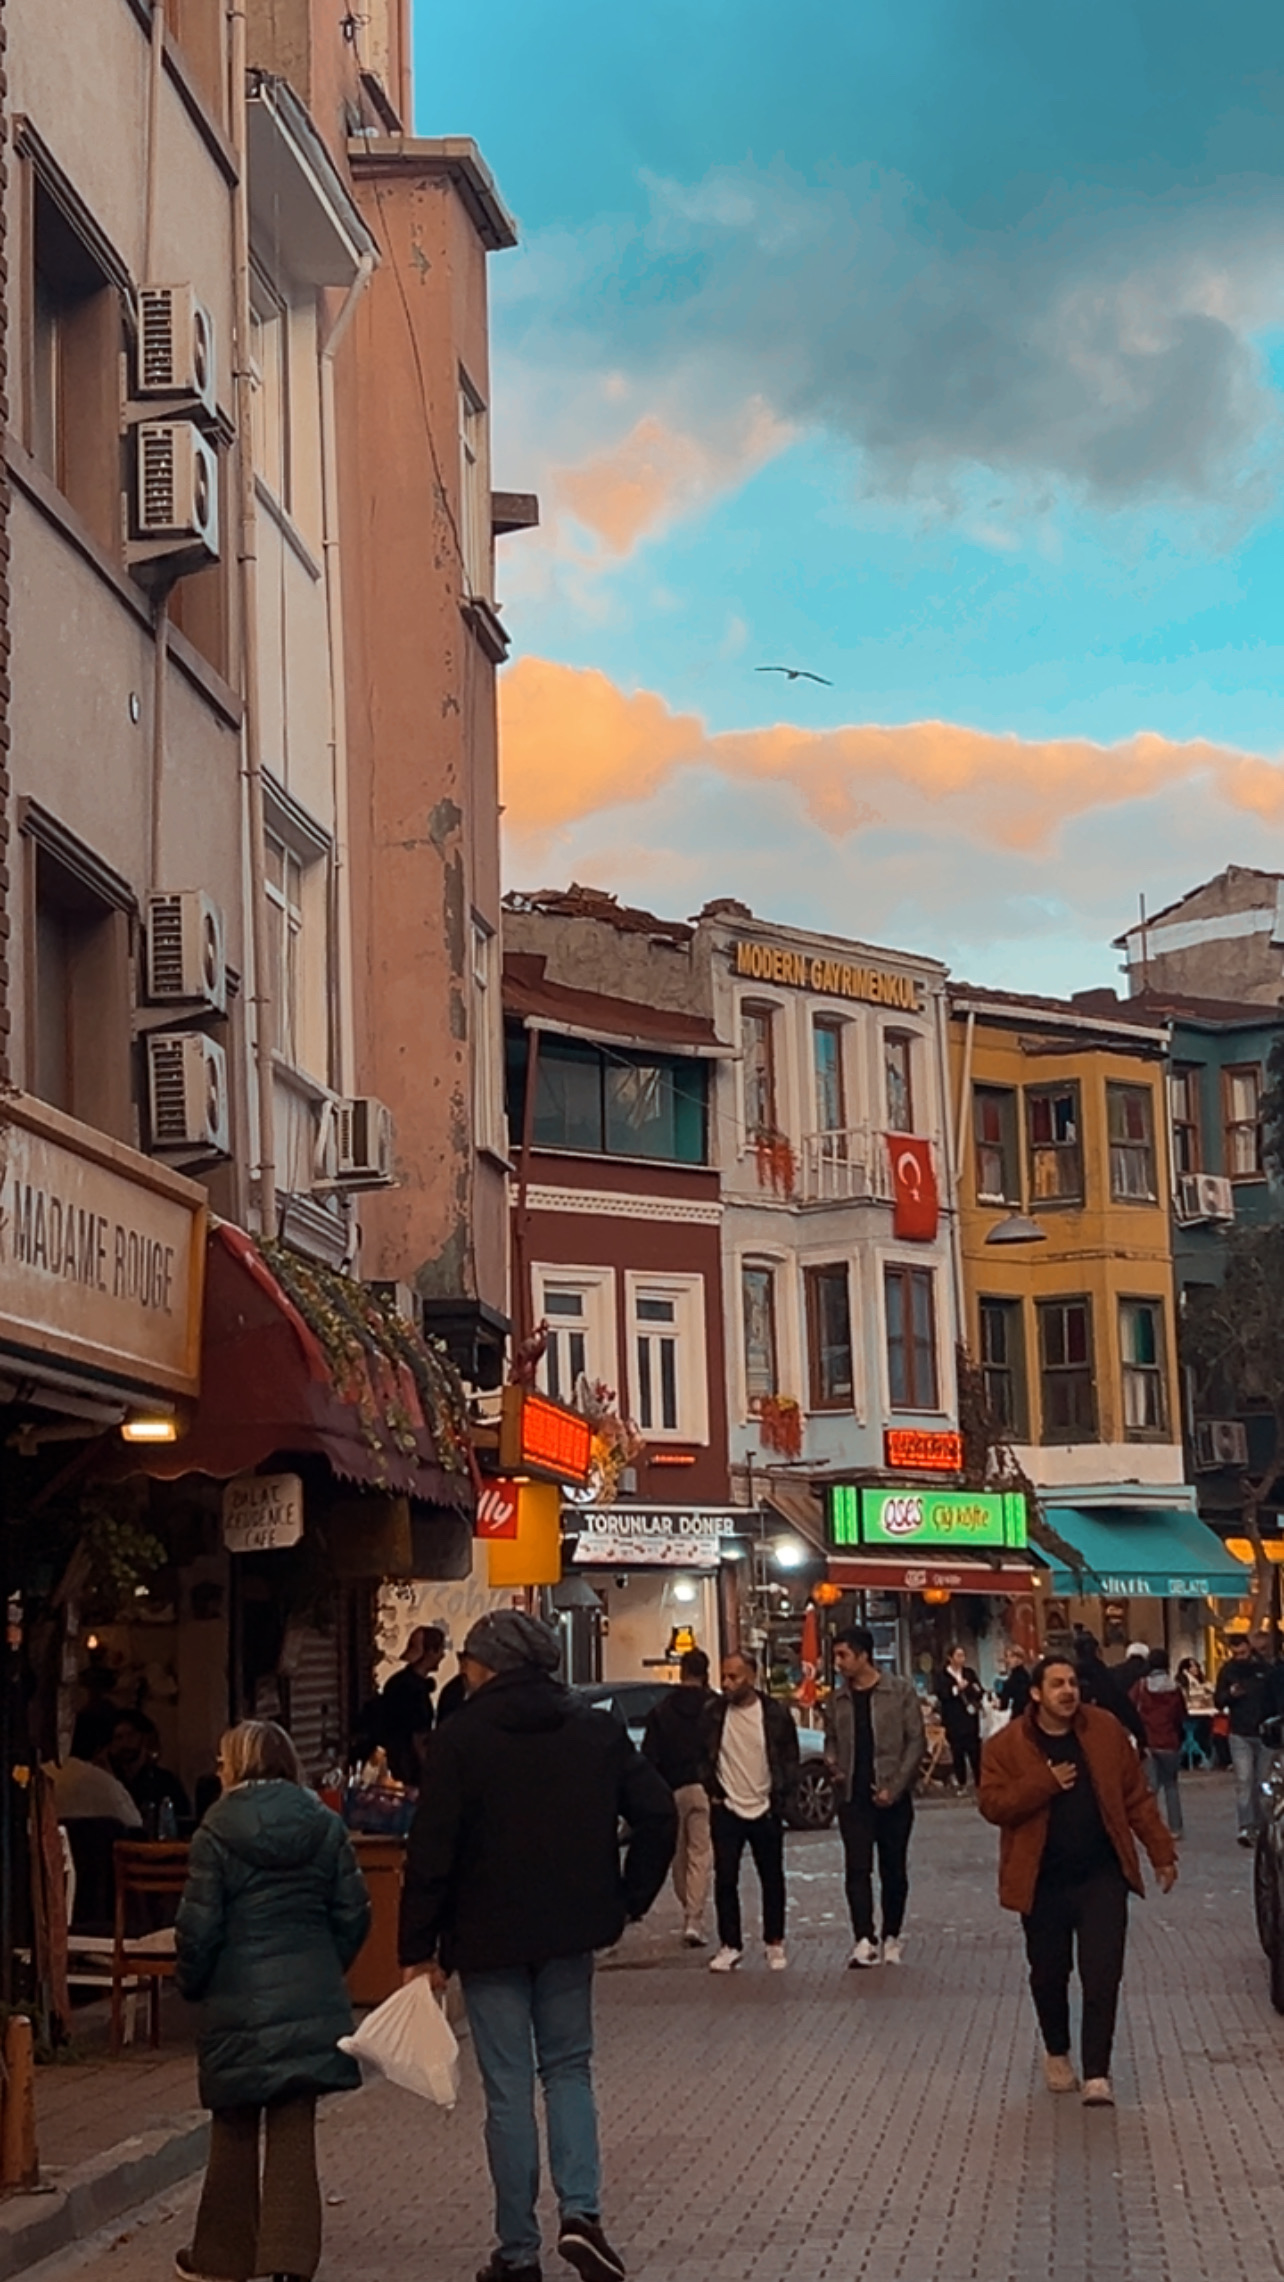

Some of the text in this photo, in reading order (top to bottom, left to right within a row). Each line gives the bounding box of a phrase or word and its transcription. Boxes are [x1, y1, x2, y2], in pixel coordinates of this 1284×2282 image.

[737, 941, 805, 986] MODERN
[13, 1180, 174, 1317] MADAME ROUGE
[584, 1513, 673, 1535] TORUNLAR
